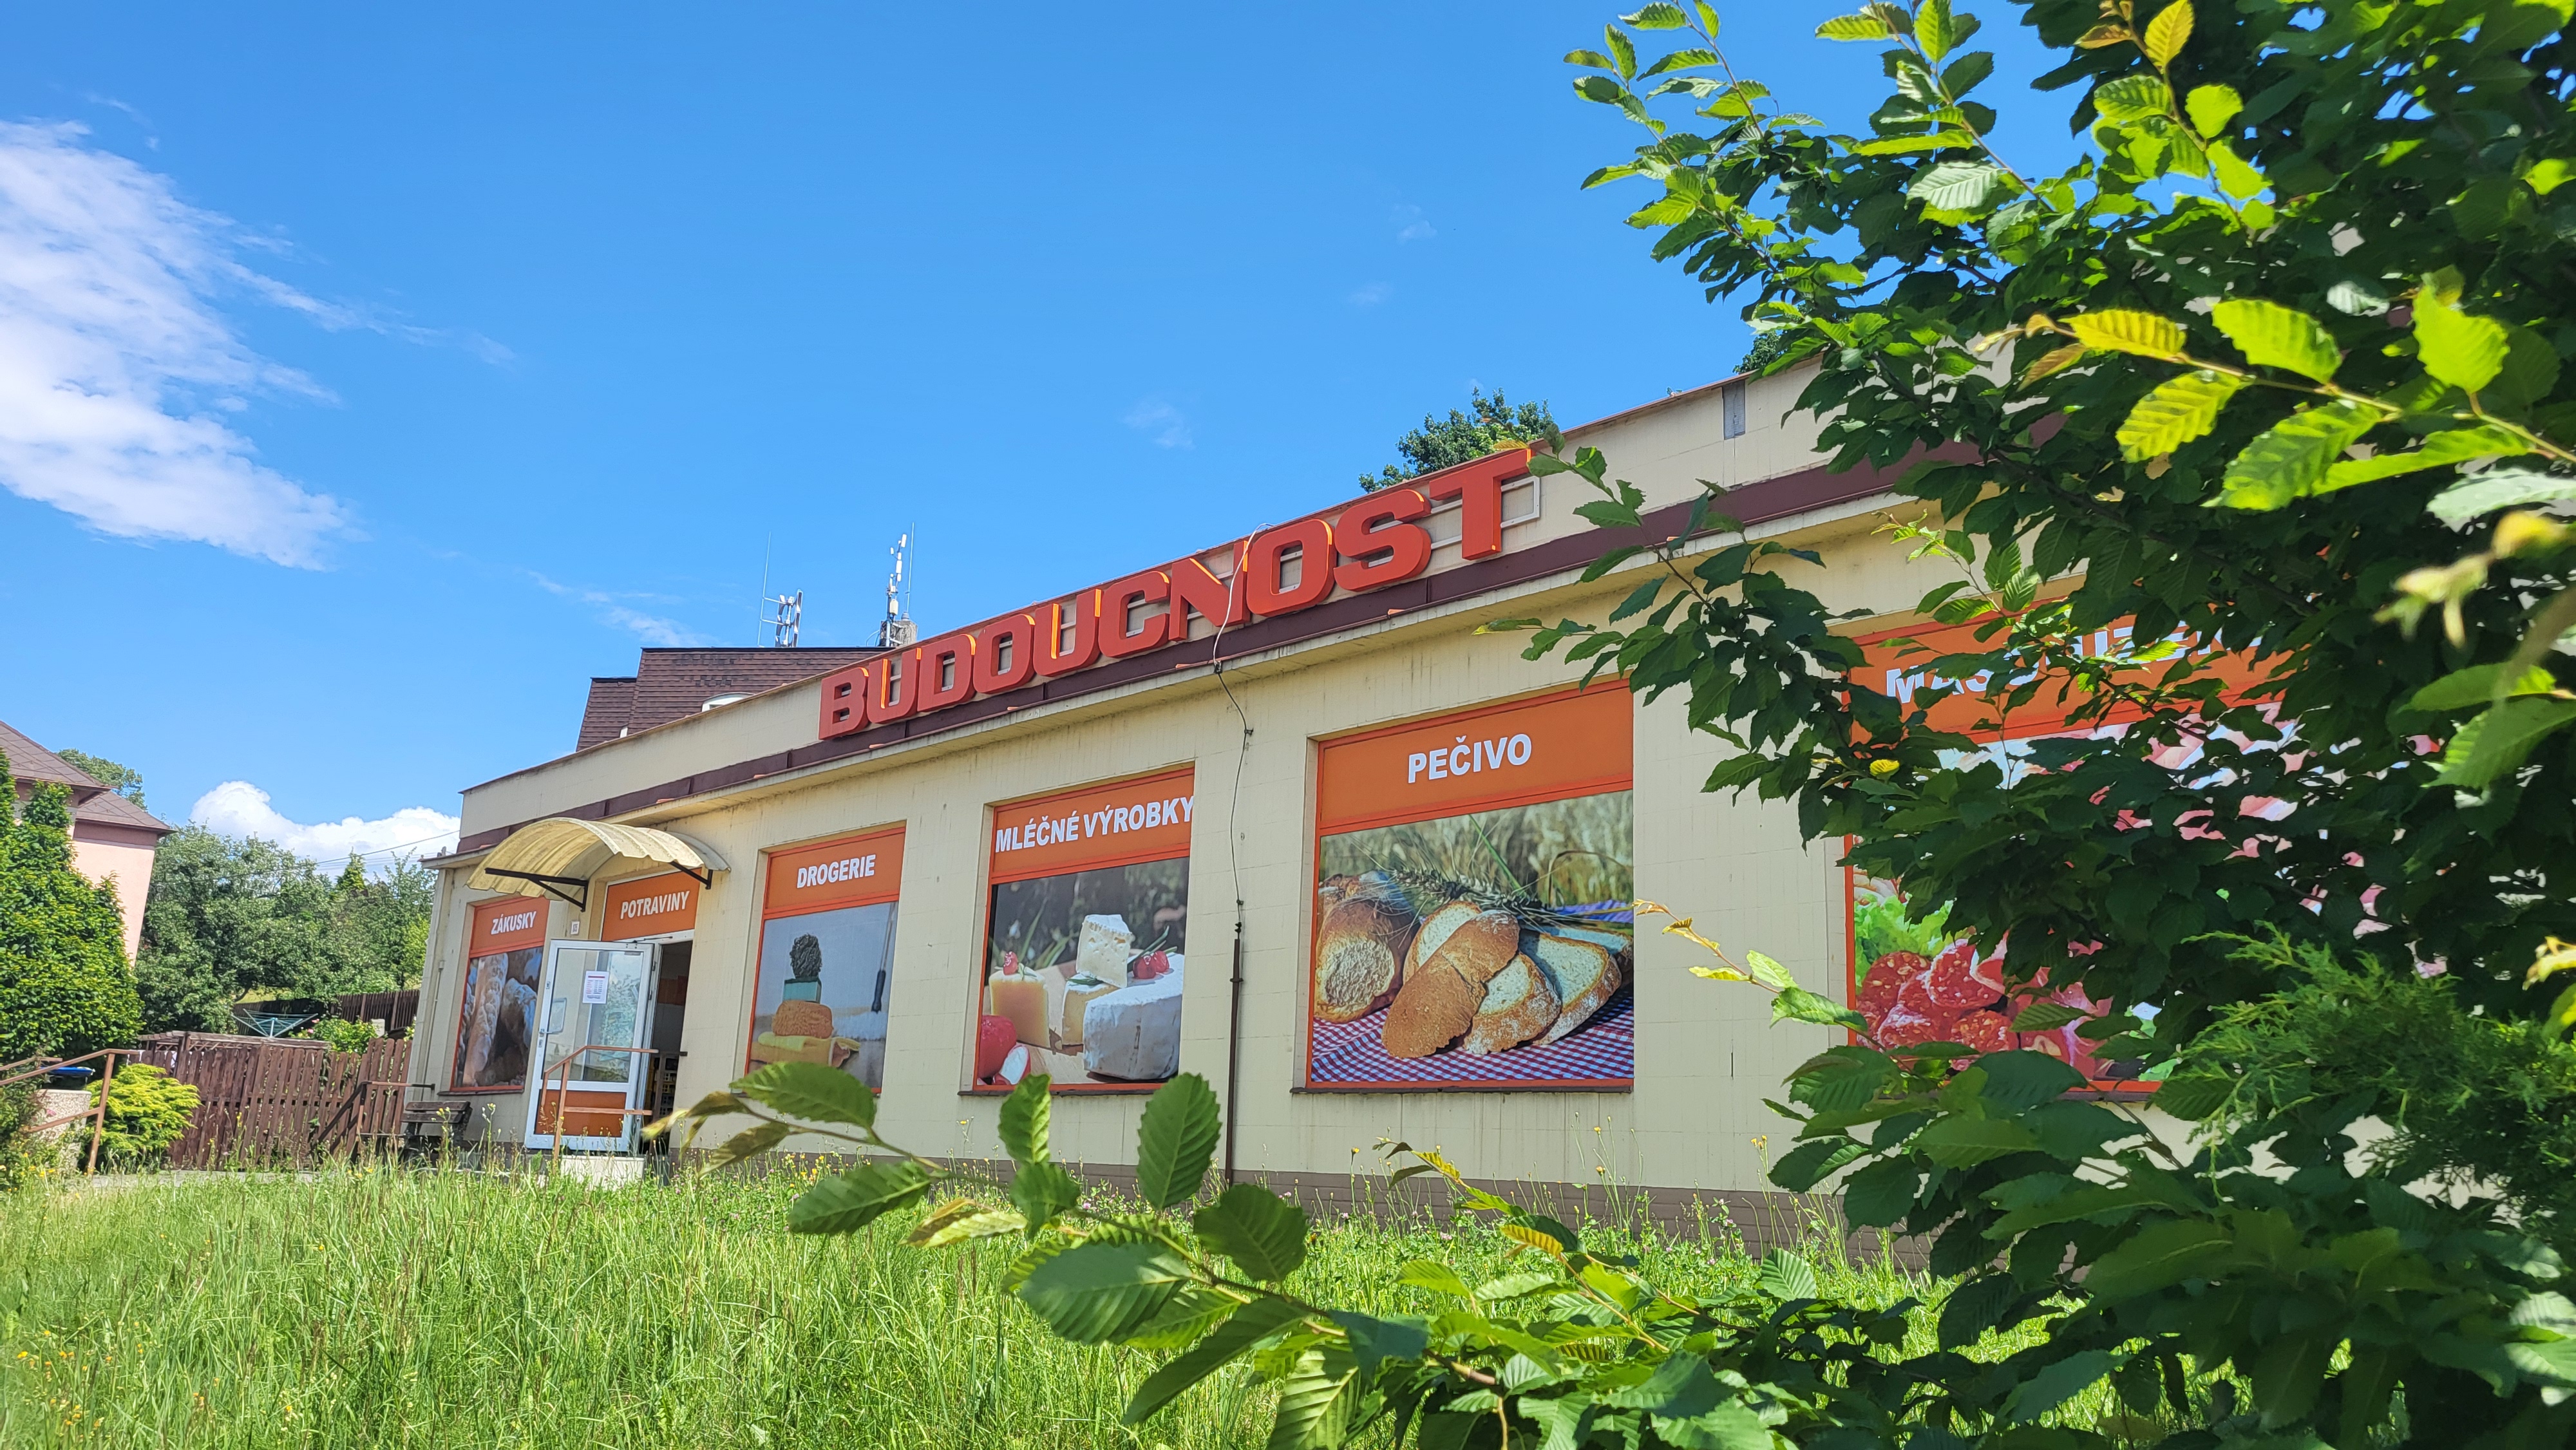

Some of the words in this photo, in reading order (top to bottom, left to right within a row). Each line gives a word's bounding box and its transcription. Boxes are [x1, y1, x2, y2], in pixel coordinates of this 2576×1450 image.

[819, 448, 1533, 740] BUDOUCNOST
[1408, 733, 1532, 784] PEČIVO
[995, 811, 1080, 853] MLÉČNÉ
[1083, 795, 1194, 838] VÝROBKY
[797, 854, 876, 889] DROGERIE
[491, 911, 537, 935] ZÁKUSKY
[620, 890, 690, 919] POTRAVINY
